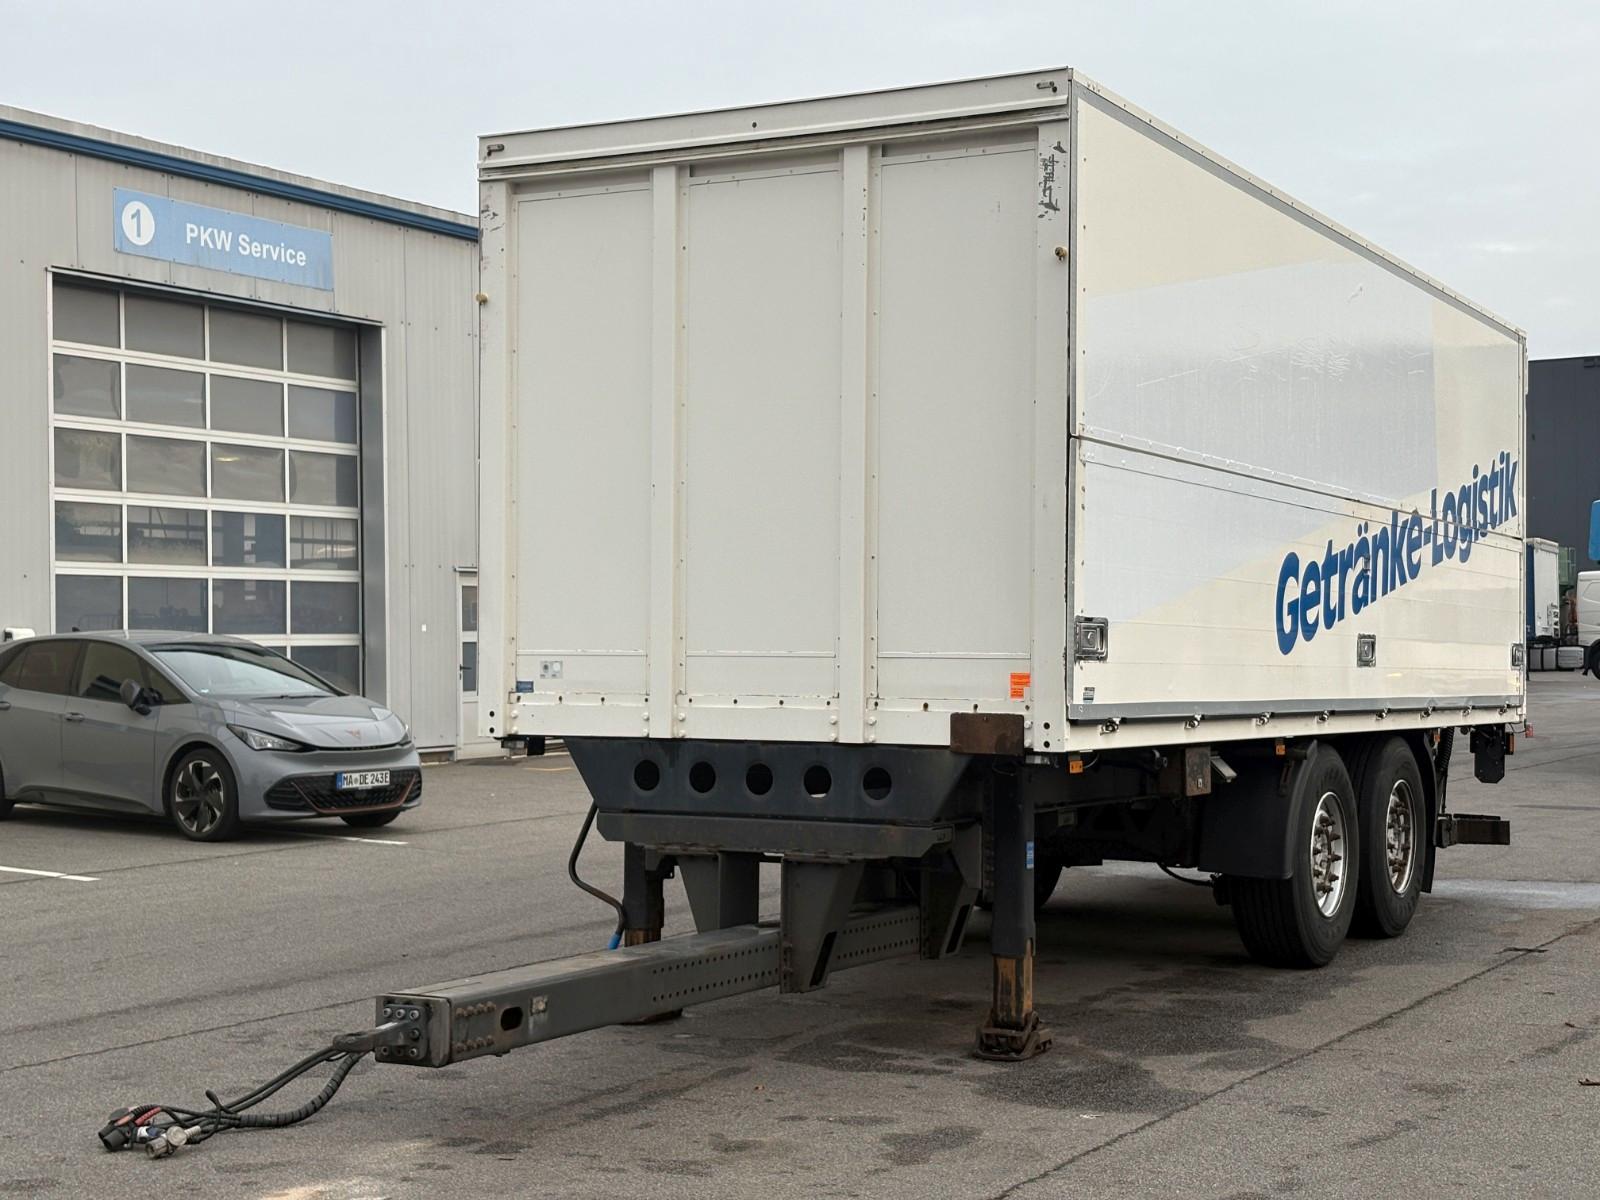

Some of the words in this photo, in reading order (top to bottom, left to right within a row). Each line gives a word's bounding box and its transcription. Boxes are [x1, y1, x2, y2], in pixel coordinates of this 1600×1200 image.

[130, 208, 142, 239] 1
[186, 223, 232, 251] PKW
[238, 234, 306, 266] Service
[1275, 451, 1518, 655] Getränke-Logistik
[342, 774, 353, 786] MA
[359, 773, 369, 785] DE
